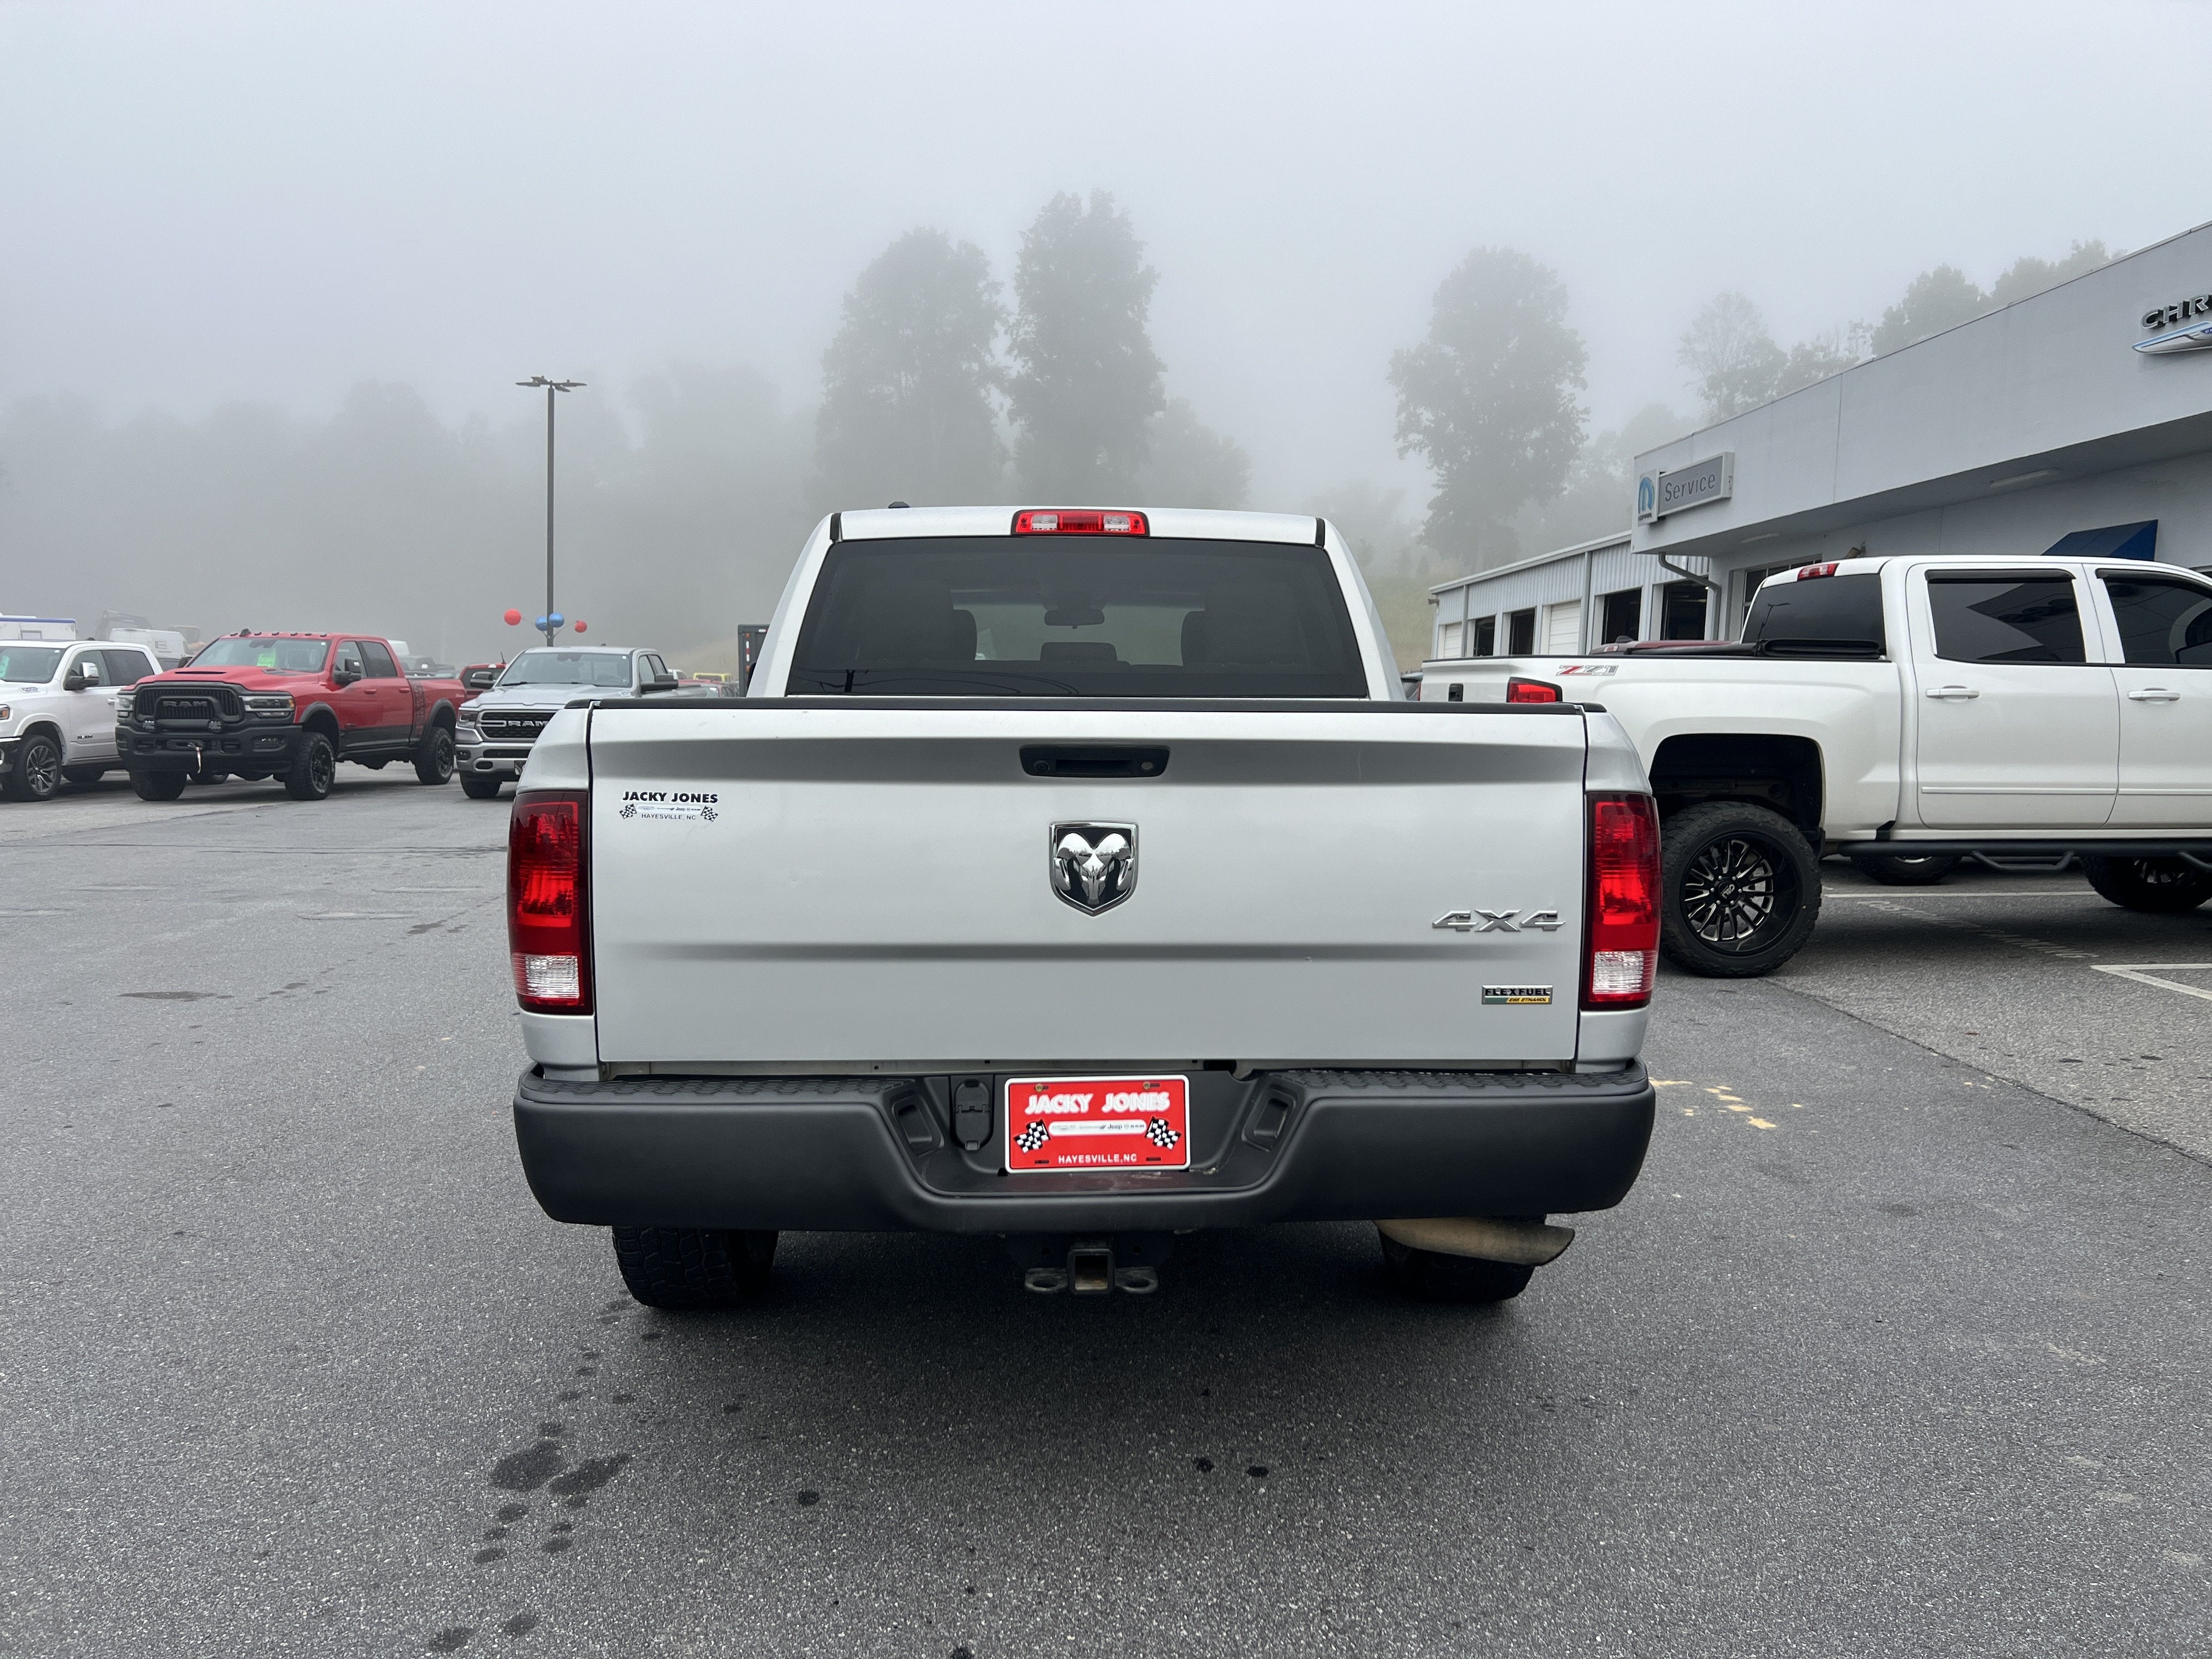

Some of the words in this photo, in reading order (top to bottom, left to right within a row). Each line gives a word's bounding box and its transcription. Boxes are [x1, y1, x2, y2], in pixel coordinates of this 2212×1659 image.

[1664, 473, 1716, 502] Service
[1555, 665, 1619, 676] Z71
[622, 791, 668, 802] JACKY
[671, 793, 718, 803] JONES
[1025, 1093, 1093, 1114] JACKY
[1102, 1092, 1170, 1113] JONES
